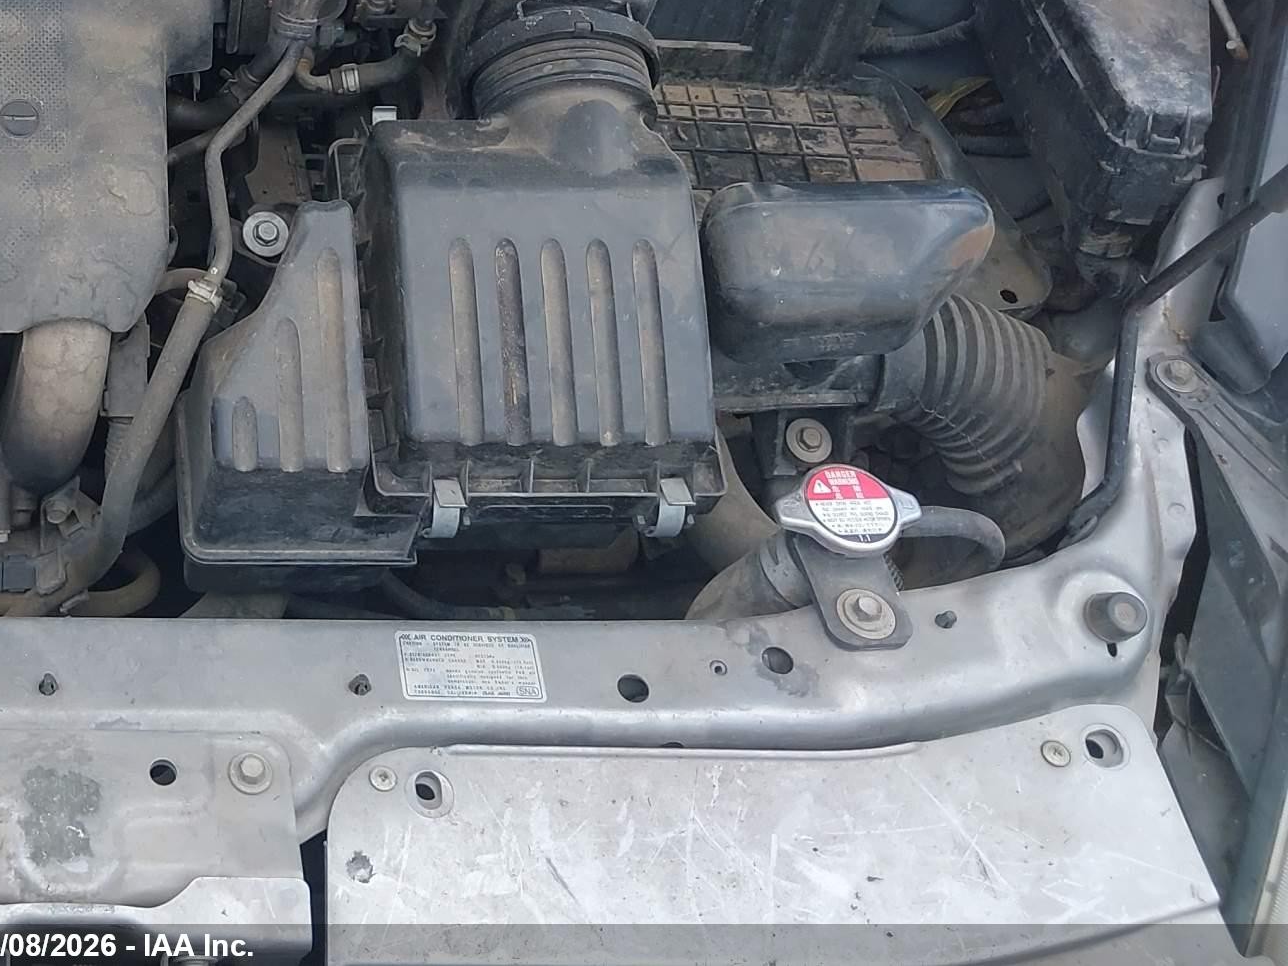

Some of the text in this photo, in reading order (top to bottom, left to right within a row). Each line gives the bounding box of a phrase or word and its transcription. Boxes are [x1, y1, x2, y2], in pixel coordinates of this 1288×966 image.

[824, 470, 856, 479] DANGER
[431, 634, 484, 643] CONDITIONER
[487, 635, 519, 643] SYSTEM
